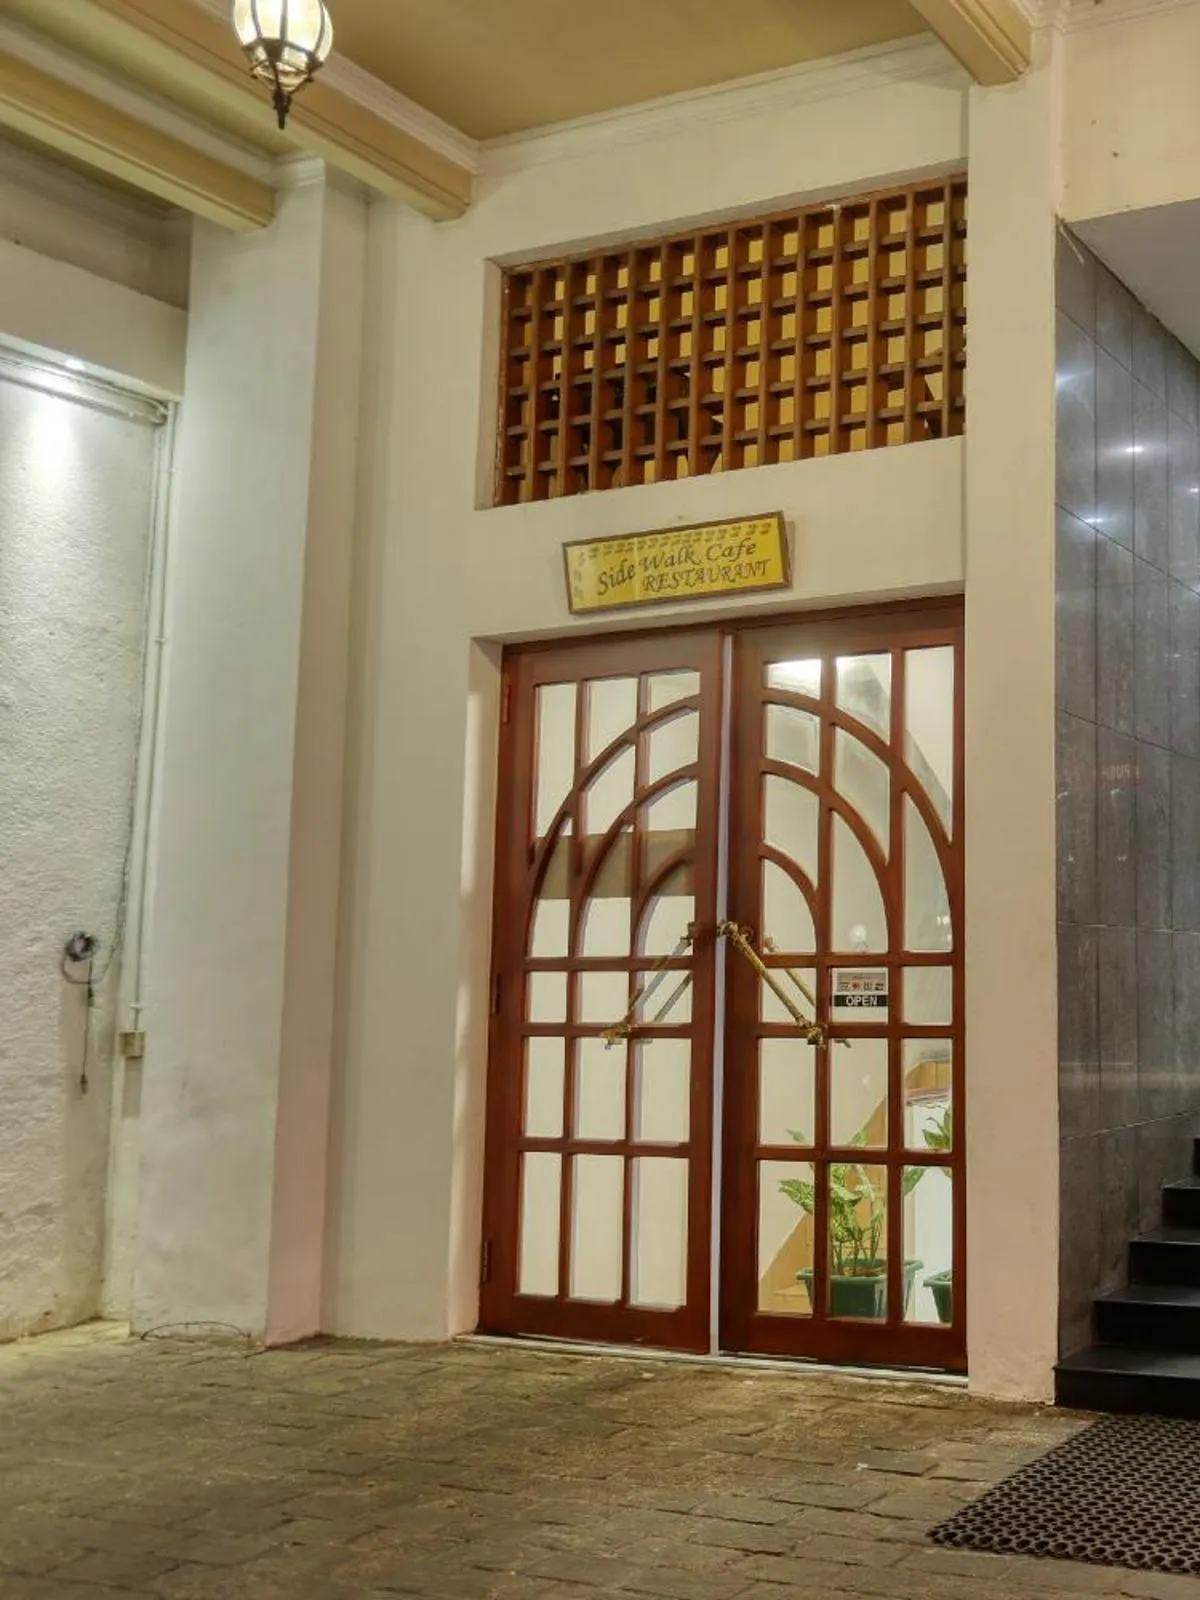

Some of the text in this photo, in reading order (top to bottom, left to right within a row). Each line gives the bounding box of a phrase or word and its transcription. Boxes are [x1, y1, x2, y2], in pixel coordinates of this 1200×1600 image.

[597, 557, 636, 596] Side
[705, 537, 757, 563] Cafe
[641, 558, 772, 593] RESTAURANT
[846, 995, 878, 1007] OPEN
